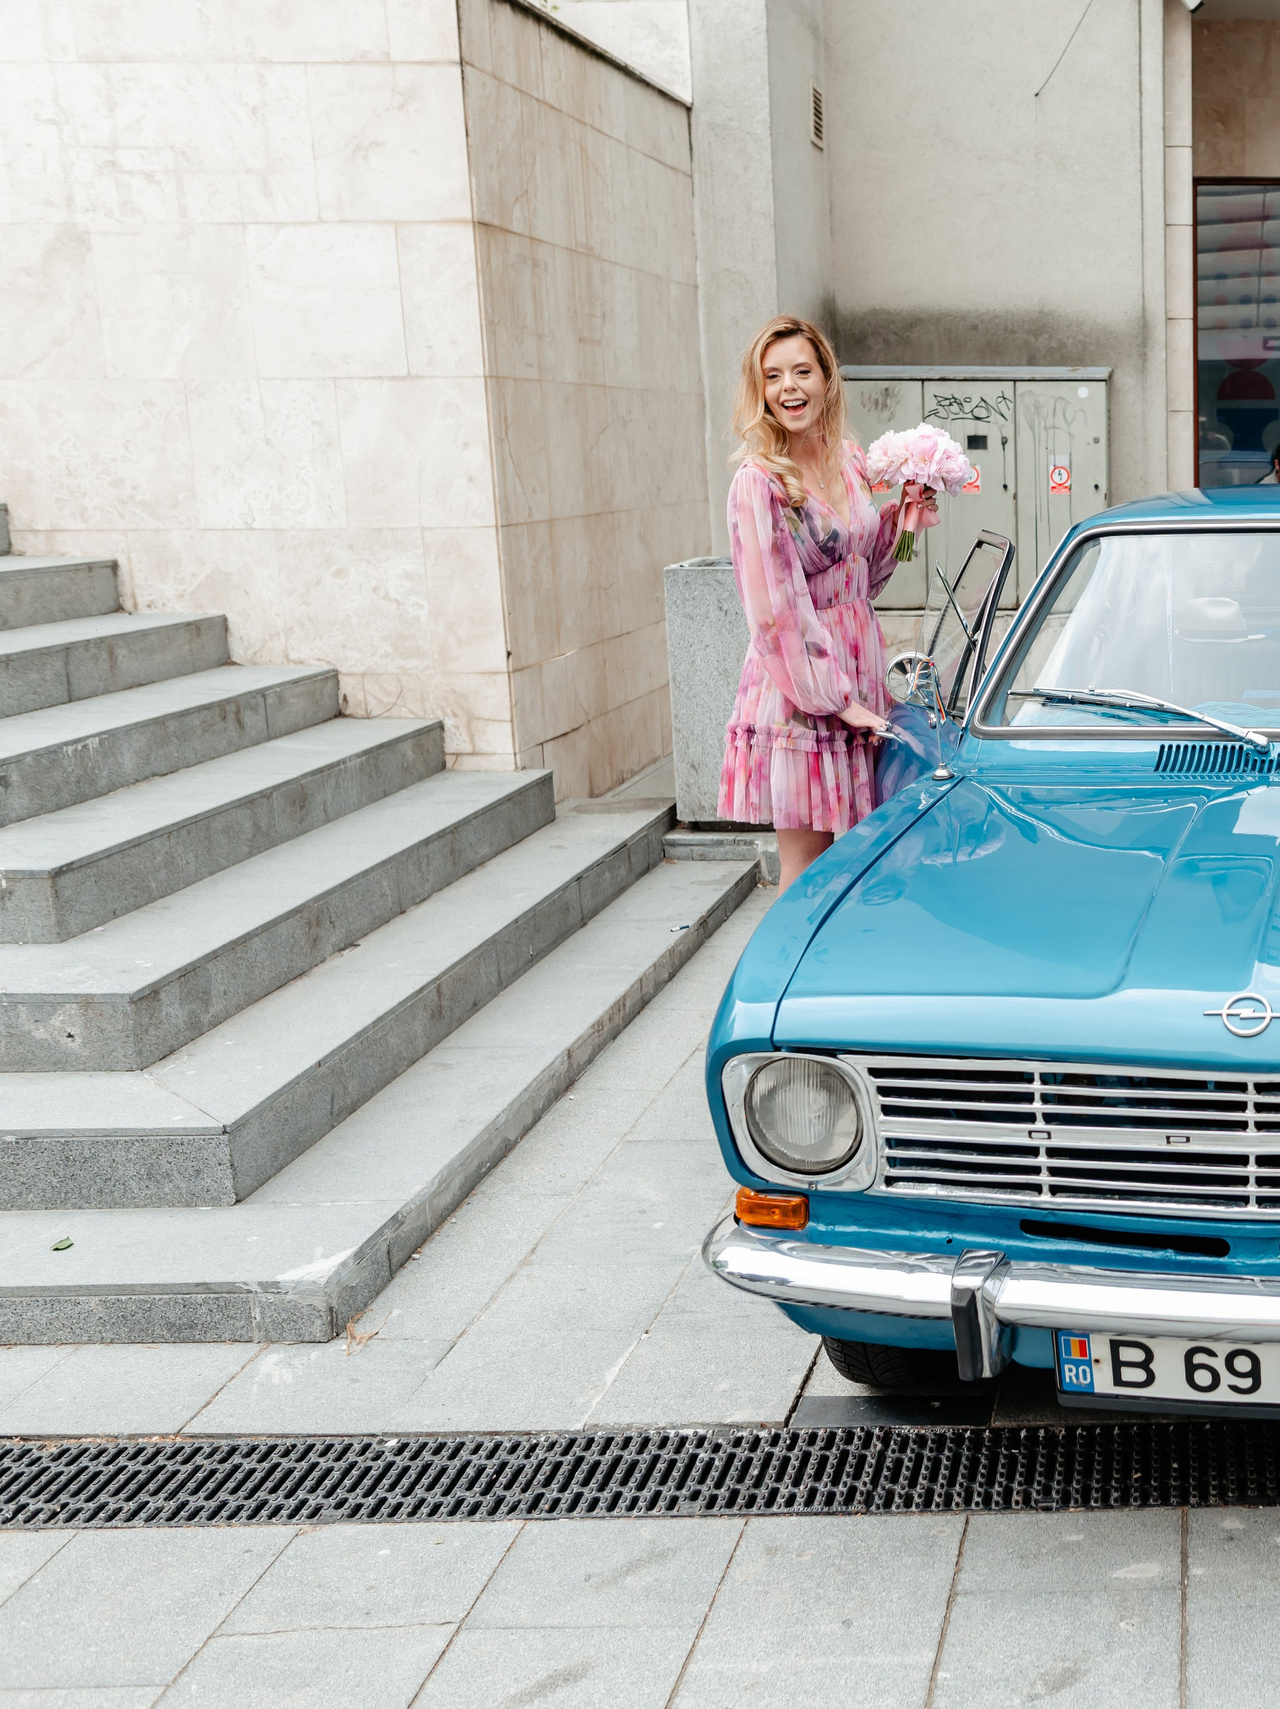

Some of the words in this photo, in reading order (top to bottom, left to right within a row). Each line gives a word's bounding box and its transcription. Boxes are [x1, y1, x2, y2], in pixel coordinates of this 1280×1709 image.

[1064, 1364, 1091, 1385] RO
[1109, 1339, 1155, 1389] B
[1183, 1345, 1262, 1395] 69
